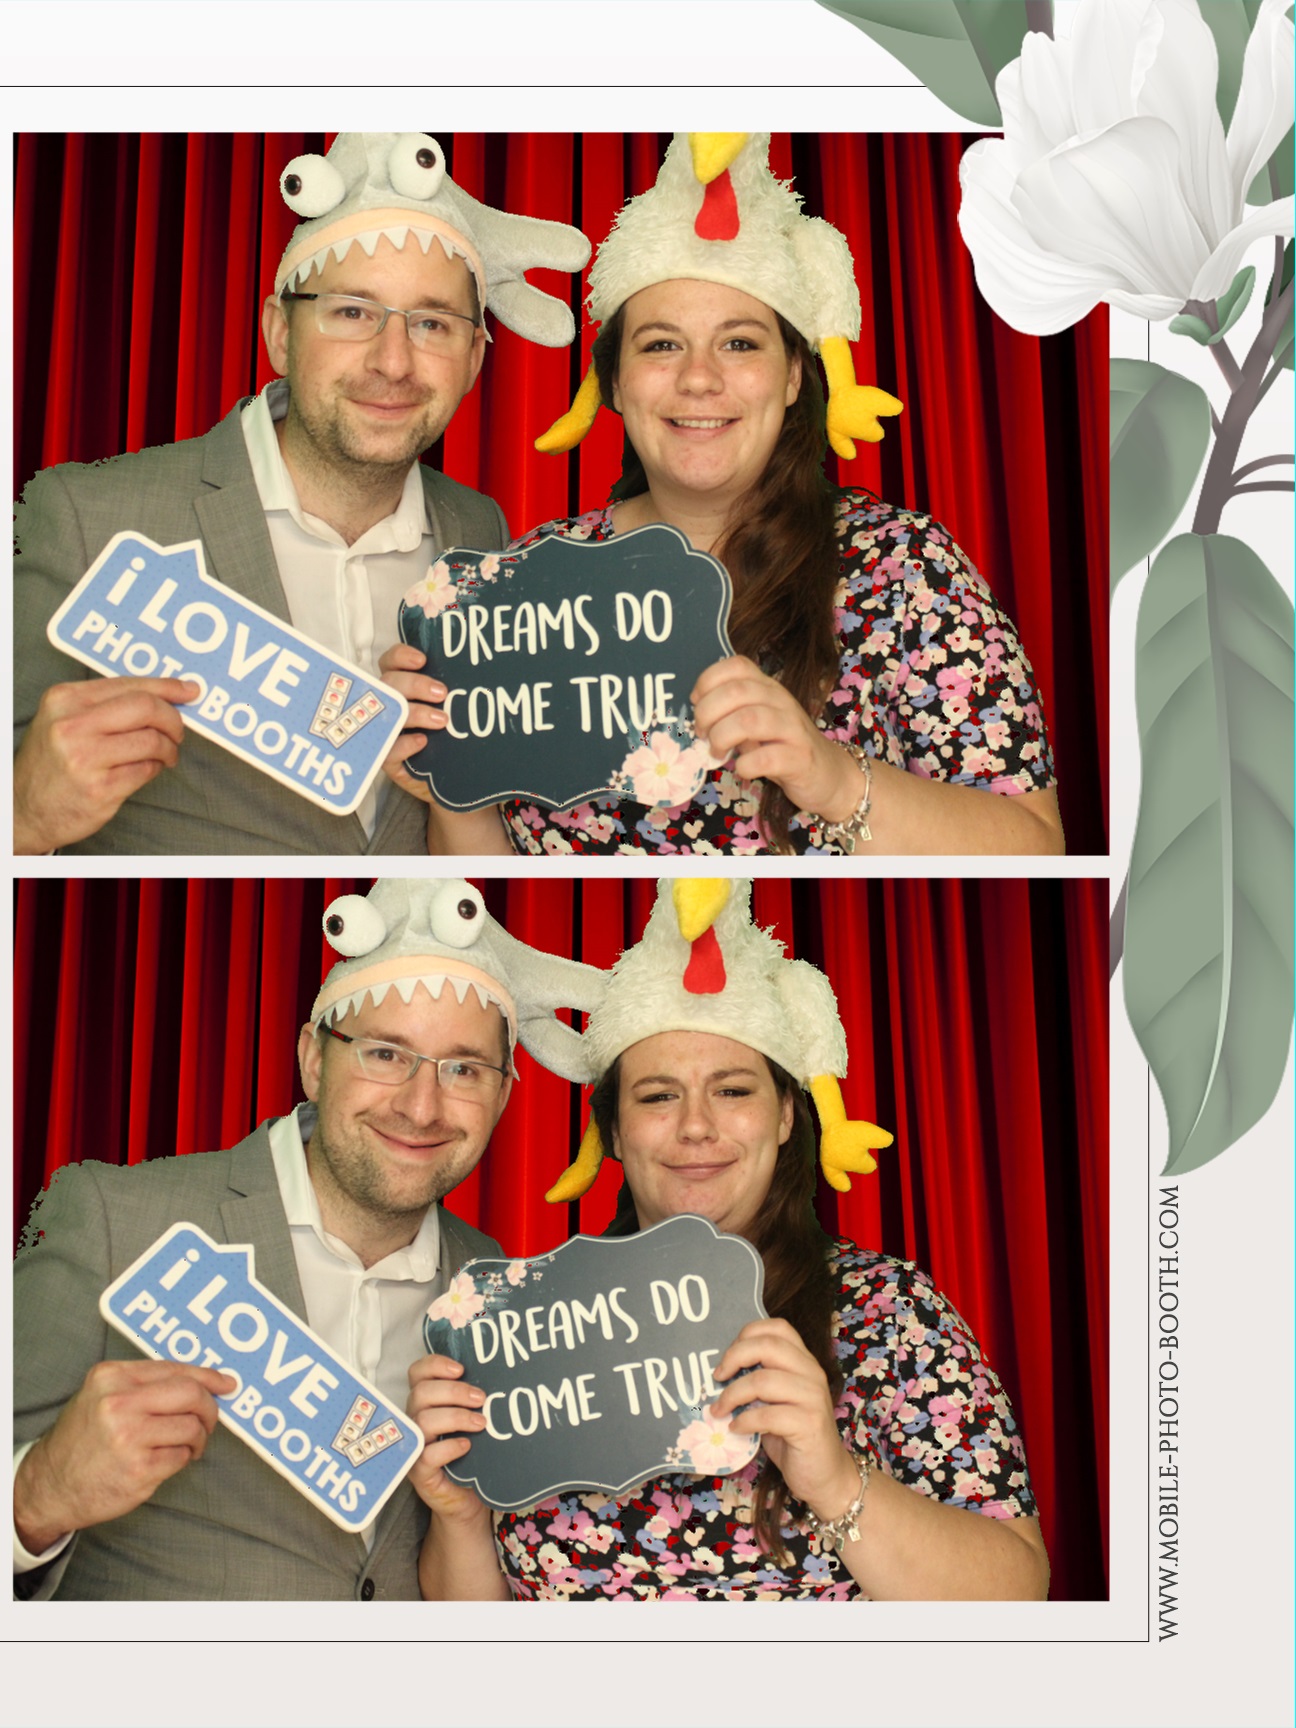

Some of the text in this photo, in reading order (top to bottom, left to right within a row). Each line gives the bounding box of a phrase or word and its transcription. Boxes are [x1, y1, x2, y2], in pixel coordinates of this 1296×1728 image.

[138, 578, 310, 708] LOVE
[442, 590, 672, 666] DREAMS DO
[443, 673, 678, 739] COME TRUE
[187, 1274, 340, 1418] LOVE
[472, 1274, 710, 1368] DREAMS DO
[482, 1349, 723, 1440] COME TRUE
